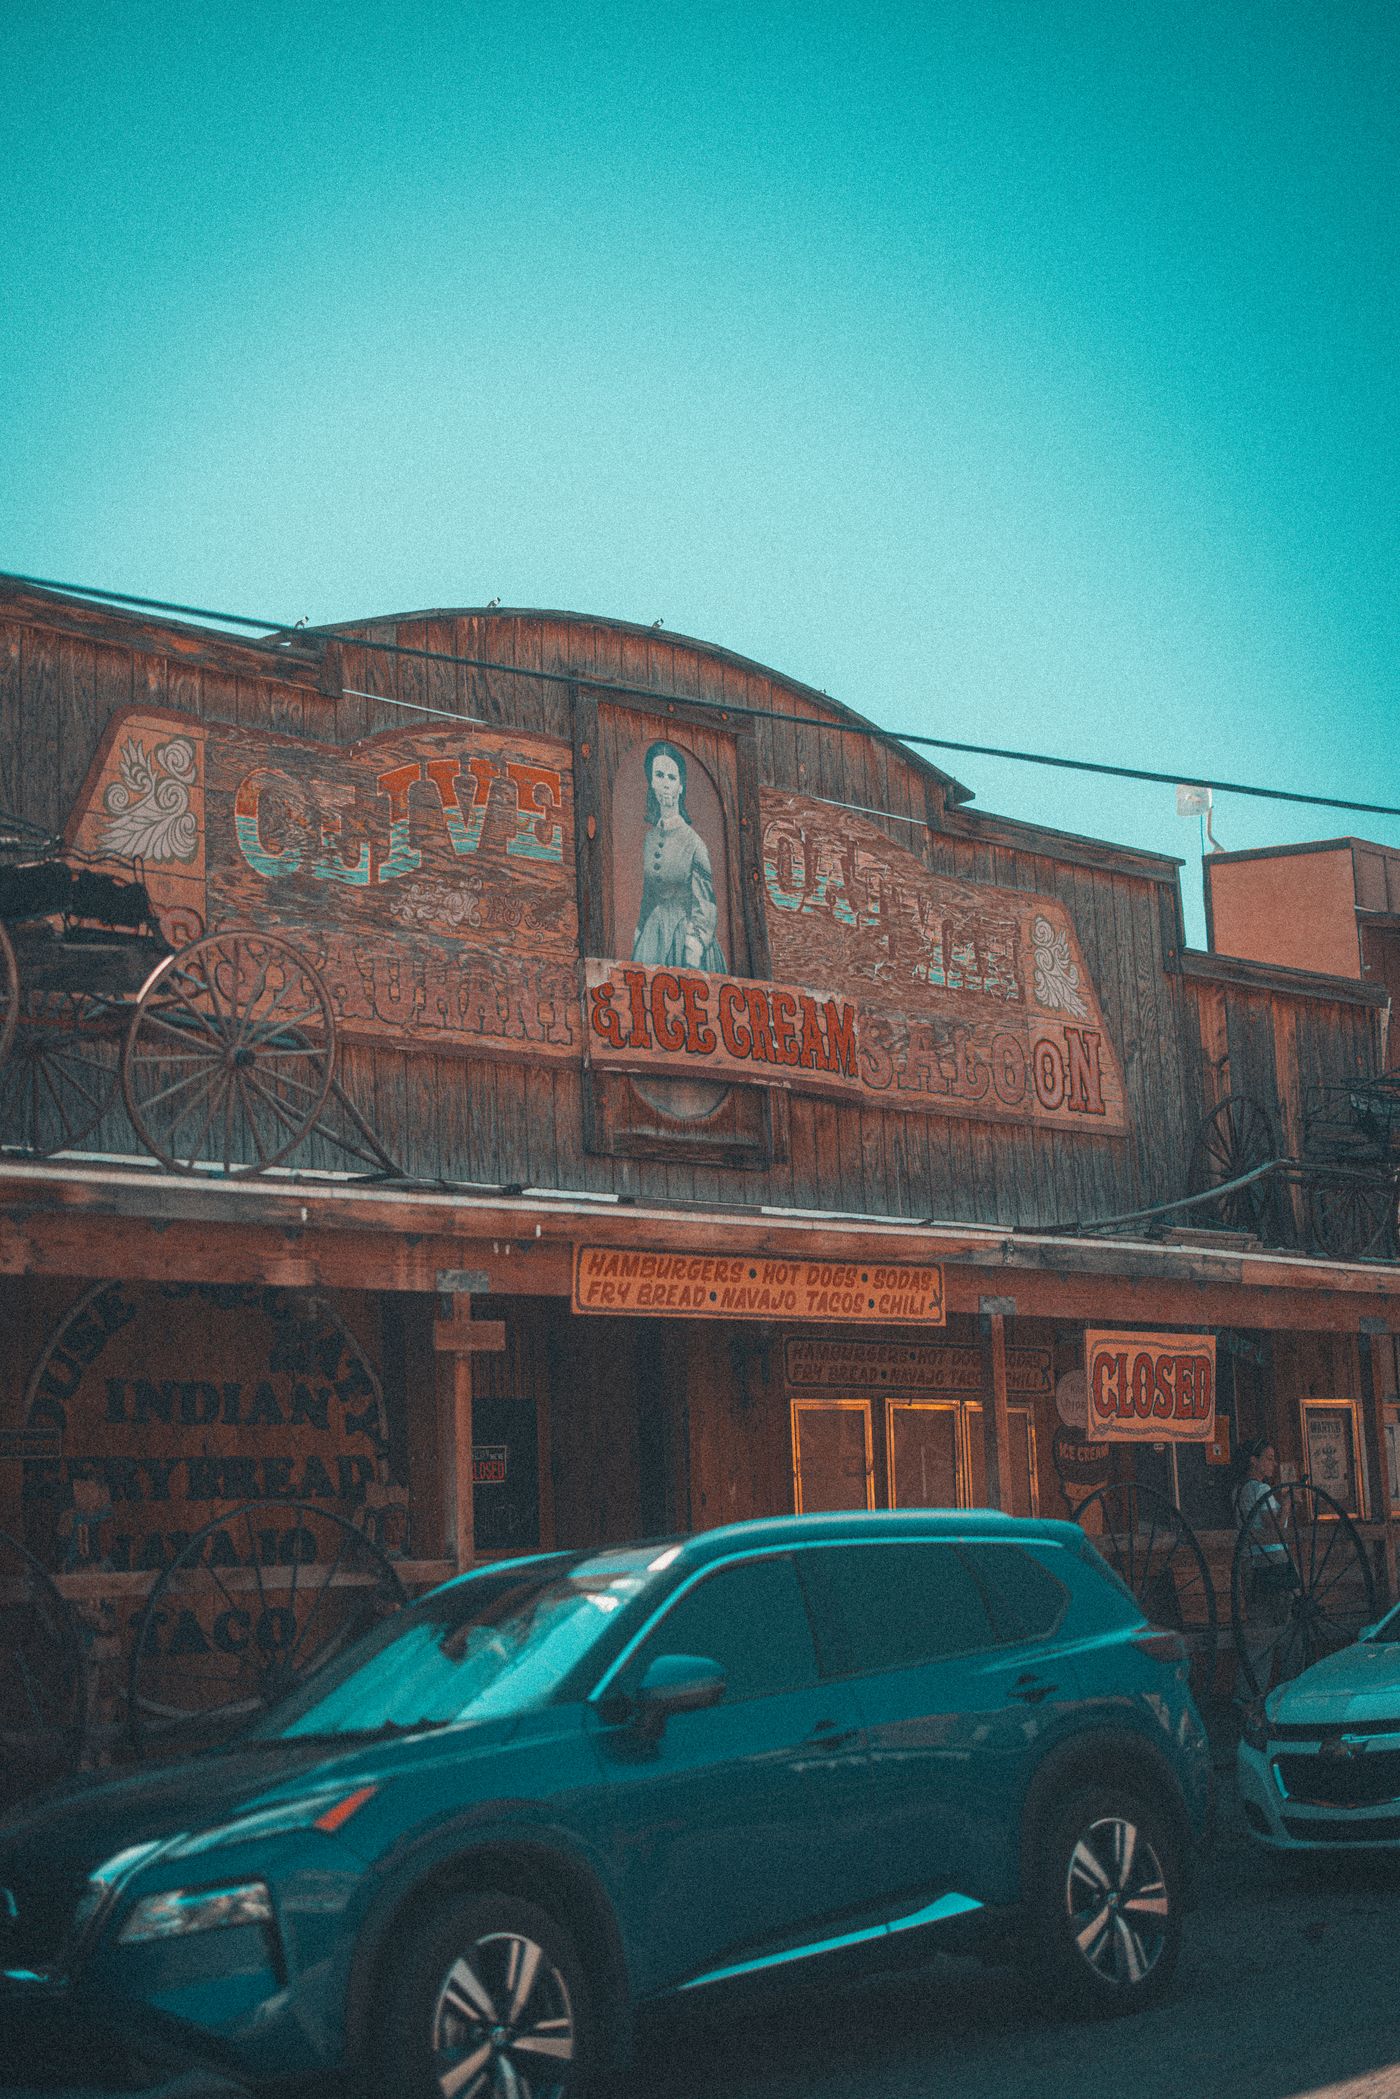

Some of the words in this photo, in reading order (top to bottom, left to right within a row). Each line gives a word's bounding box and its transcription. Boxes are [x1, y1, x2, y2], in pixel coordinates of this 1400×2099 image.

[591, 980, 627, 1050] &
[622, 970, 717, 1055] ICE
[715, 983, 859, 1079] CREAM
[858, 1008, 1107, 1117] SALOON
[587, 1253, 744, 1285] HAMBURGERS
[761, 1261, 800, 1288] HOT
[805, 1264, 857, 1291] DOGS
[871, 1267, 932, 1293] SODAS
[586, 1280, 630, 1306] FRY
[636, 1282, 708, 1310] BREAD
[719, 1286, 797, 1312] NAVAJO
[805, 1289, 863, 1315] TACOS
[877, 1293, 927, 1317] CHILI
[792, 1342, 909, 1365] HAMBURGERS
[917, 1347, 946, 1367] HOT
[951, 1350, 983, 1368] DOG
[792, 1364, 824, 1382] FRY
[827, 1366, 879, 1385] BREAD
[889, 1368, 946, 1388] NAVAJO
[950, 1370, 983, 1389] TACO
[1092, 1351, 1212, 1420] CLOSED
[103, 1376, 332, 1427] INDIAN
[472, 1460, 506, 1480] LOSED
[1059, 1442, 1076, 1460] ICE
[1078, 1443, 1109, 1462] CREAM
[130, 1607, 297, 1657] TACO
